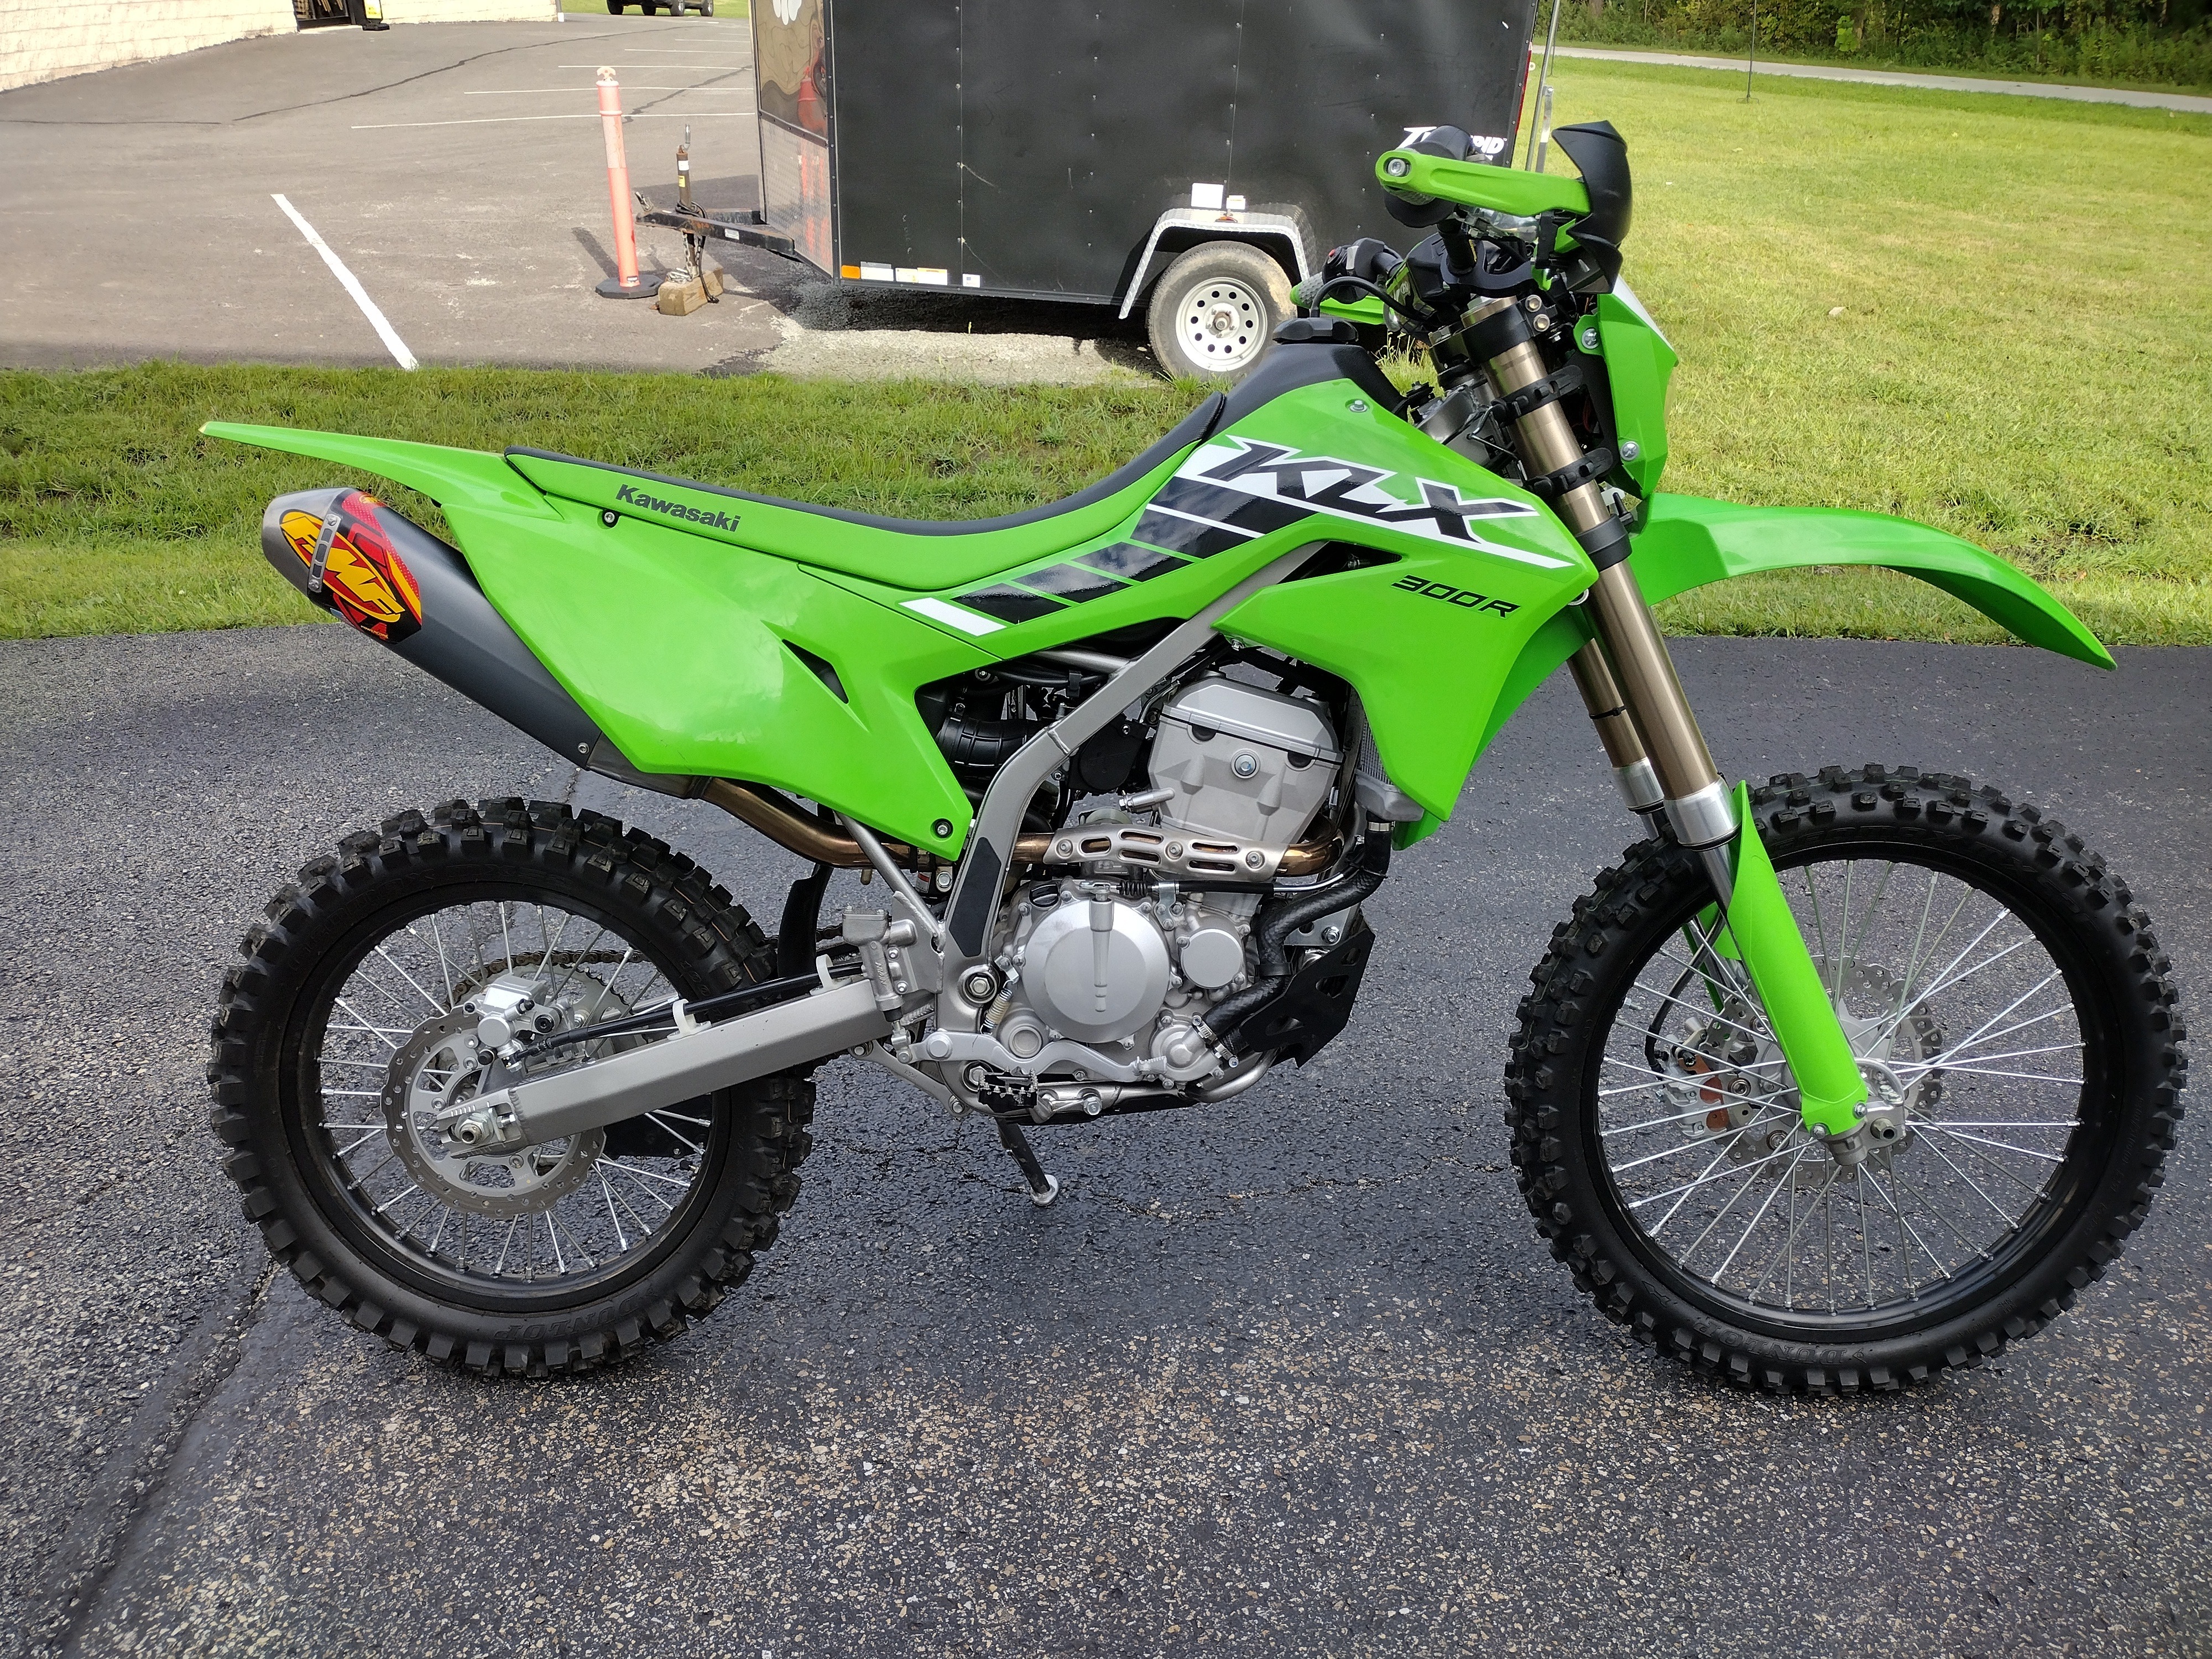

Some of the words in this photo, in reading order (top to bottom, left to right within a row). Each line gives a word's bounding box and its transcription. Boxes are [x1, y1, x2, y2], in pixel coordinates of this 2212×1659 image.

[615, 483, 742, 533] Kawasaki
[1197, 437, 1540, 545] KLX
[280, 516, 406, 614] FMF
[1390, 574, 1521, 618] 300R
[493, 1292, 645, 1340] DUNLOP
[1691, 1313, 1848, 1366] DUNLOP
